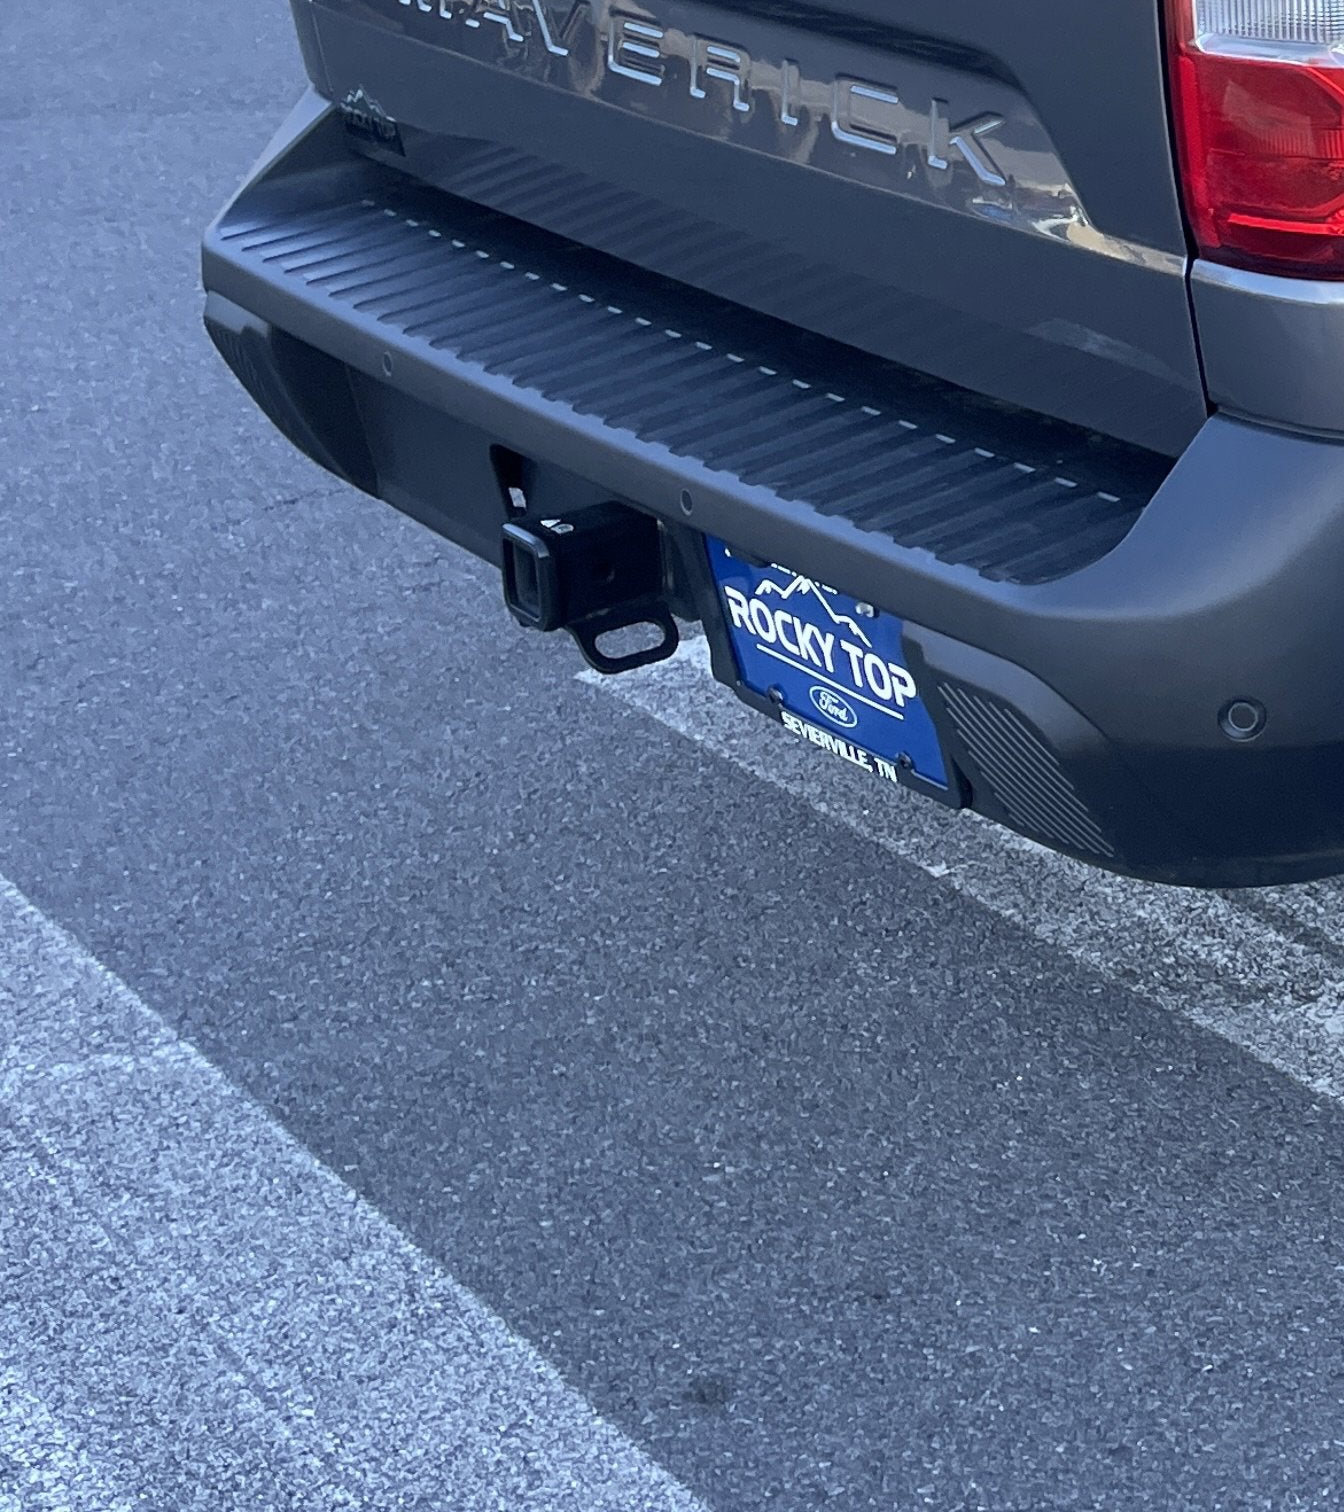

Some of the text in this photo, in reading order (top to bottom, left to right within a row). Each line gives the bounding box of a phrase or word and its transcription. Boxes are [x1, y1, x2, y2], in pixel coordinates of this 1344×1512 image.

[724, 585, 917, 707] ROCKY TOP
[818, 691, 848, 722] Ford
[873, 758, 898, 782] TN
